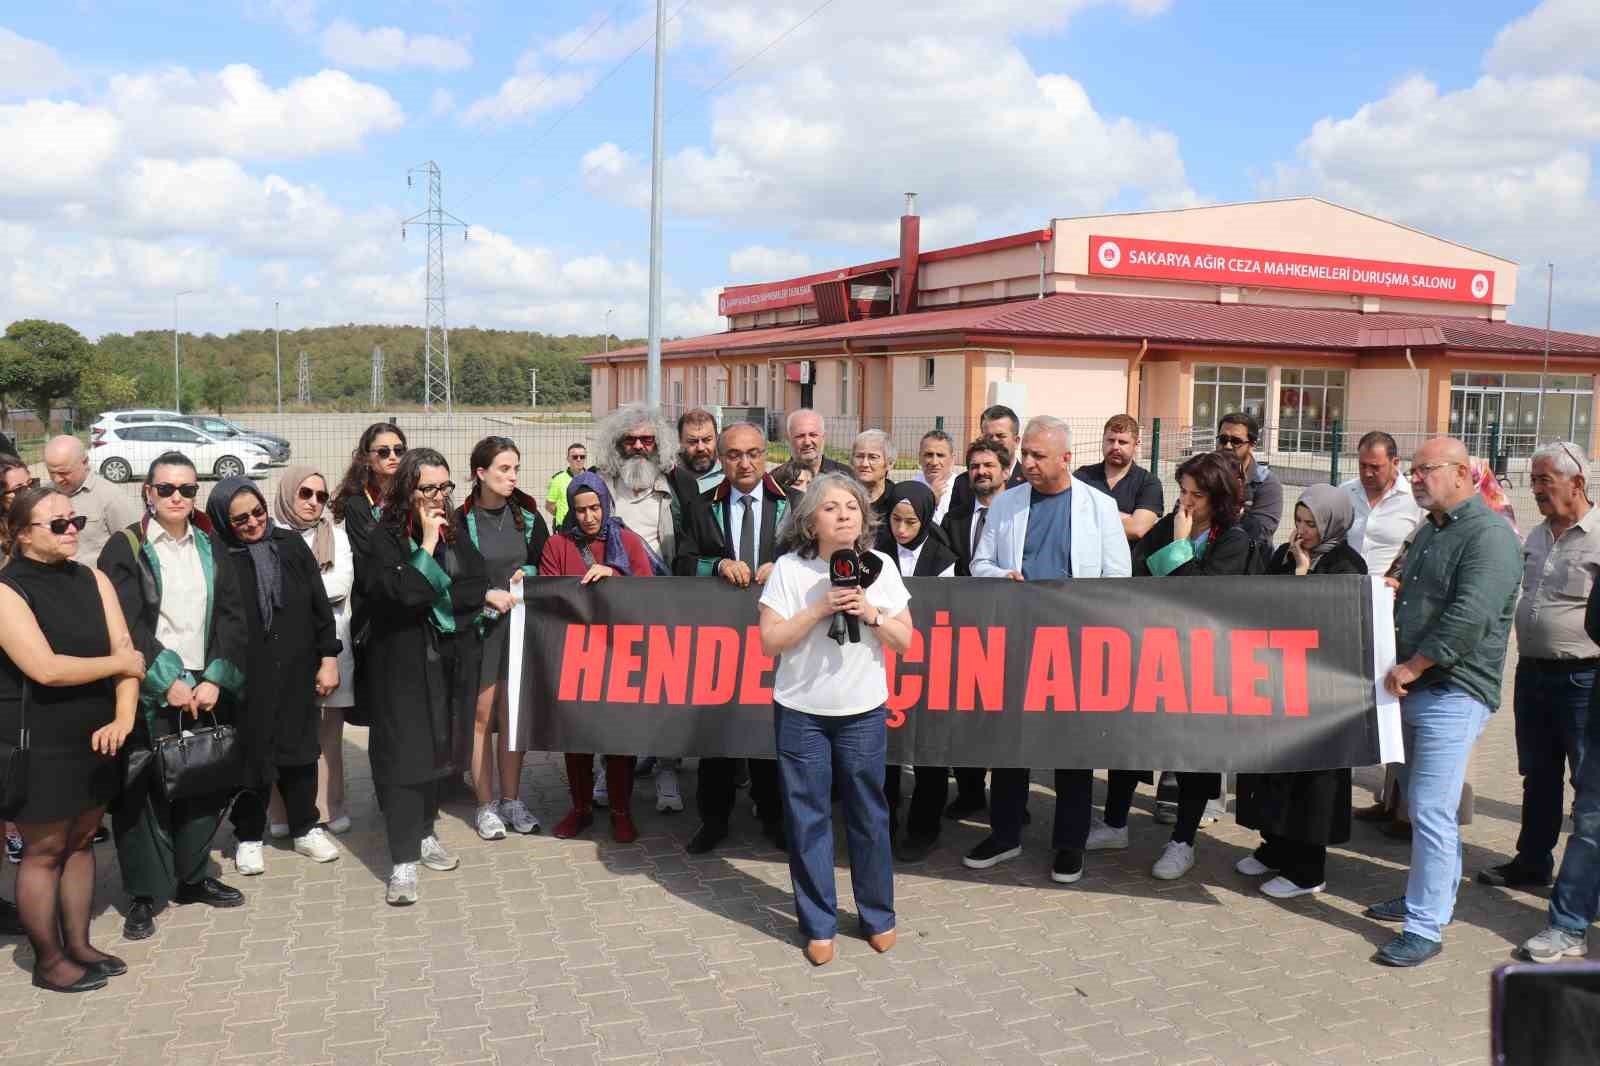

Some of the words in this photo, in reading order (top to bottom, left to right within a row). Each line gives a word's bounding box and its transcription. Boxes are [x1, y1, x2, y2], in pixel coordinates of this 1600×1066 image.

[1129, 250, 1191, 268] SAKARYA
[1194, 254, 1226, 270] AĞIR
[1228, 258, 1261, 273] CEZA
[1263, 261, 1351, 281] MAHKEMELERİ
[1353, 269, 1410, 287] DURUŞMA
[1411, 275, 1457, 290] SALONU
[558, 624, 775, 705] HENDE
[882, 610, 1006, 728] ÇİN
[1023, 626, 1319, 716] ADALET
